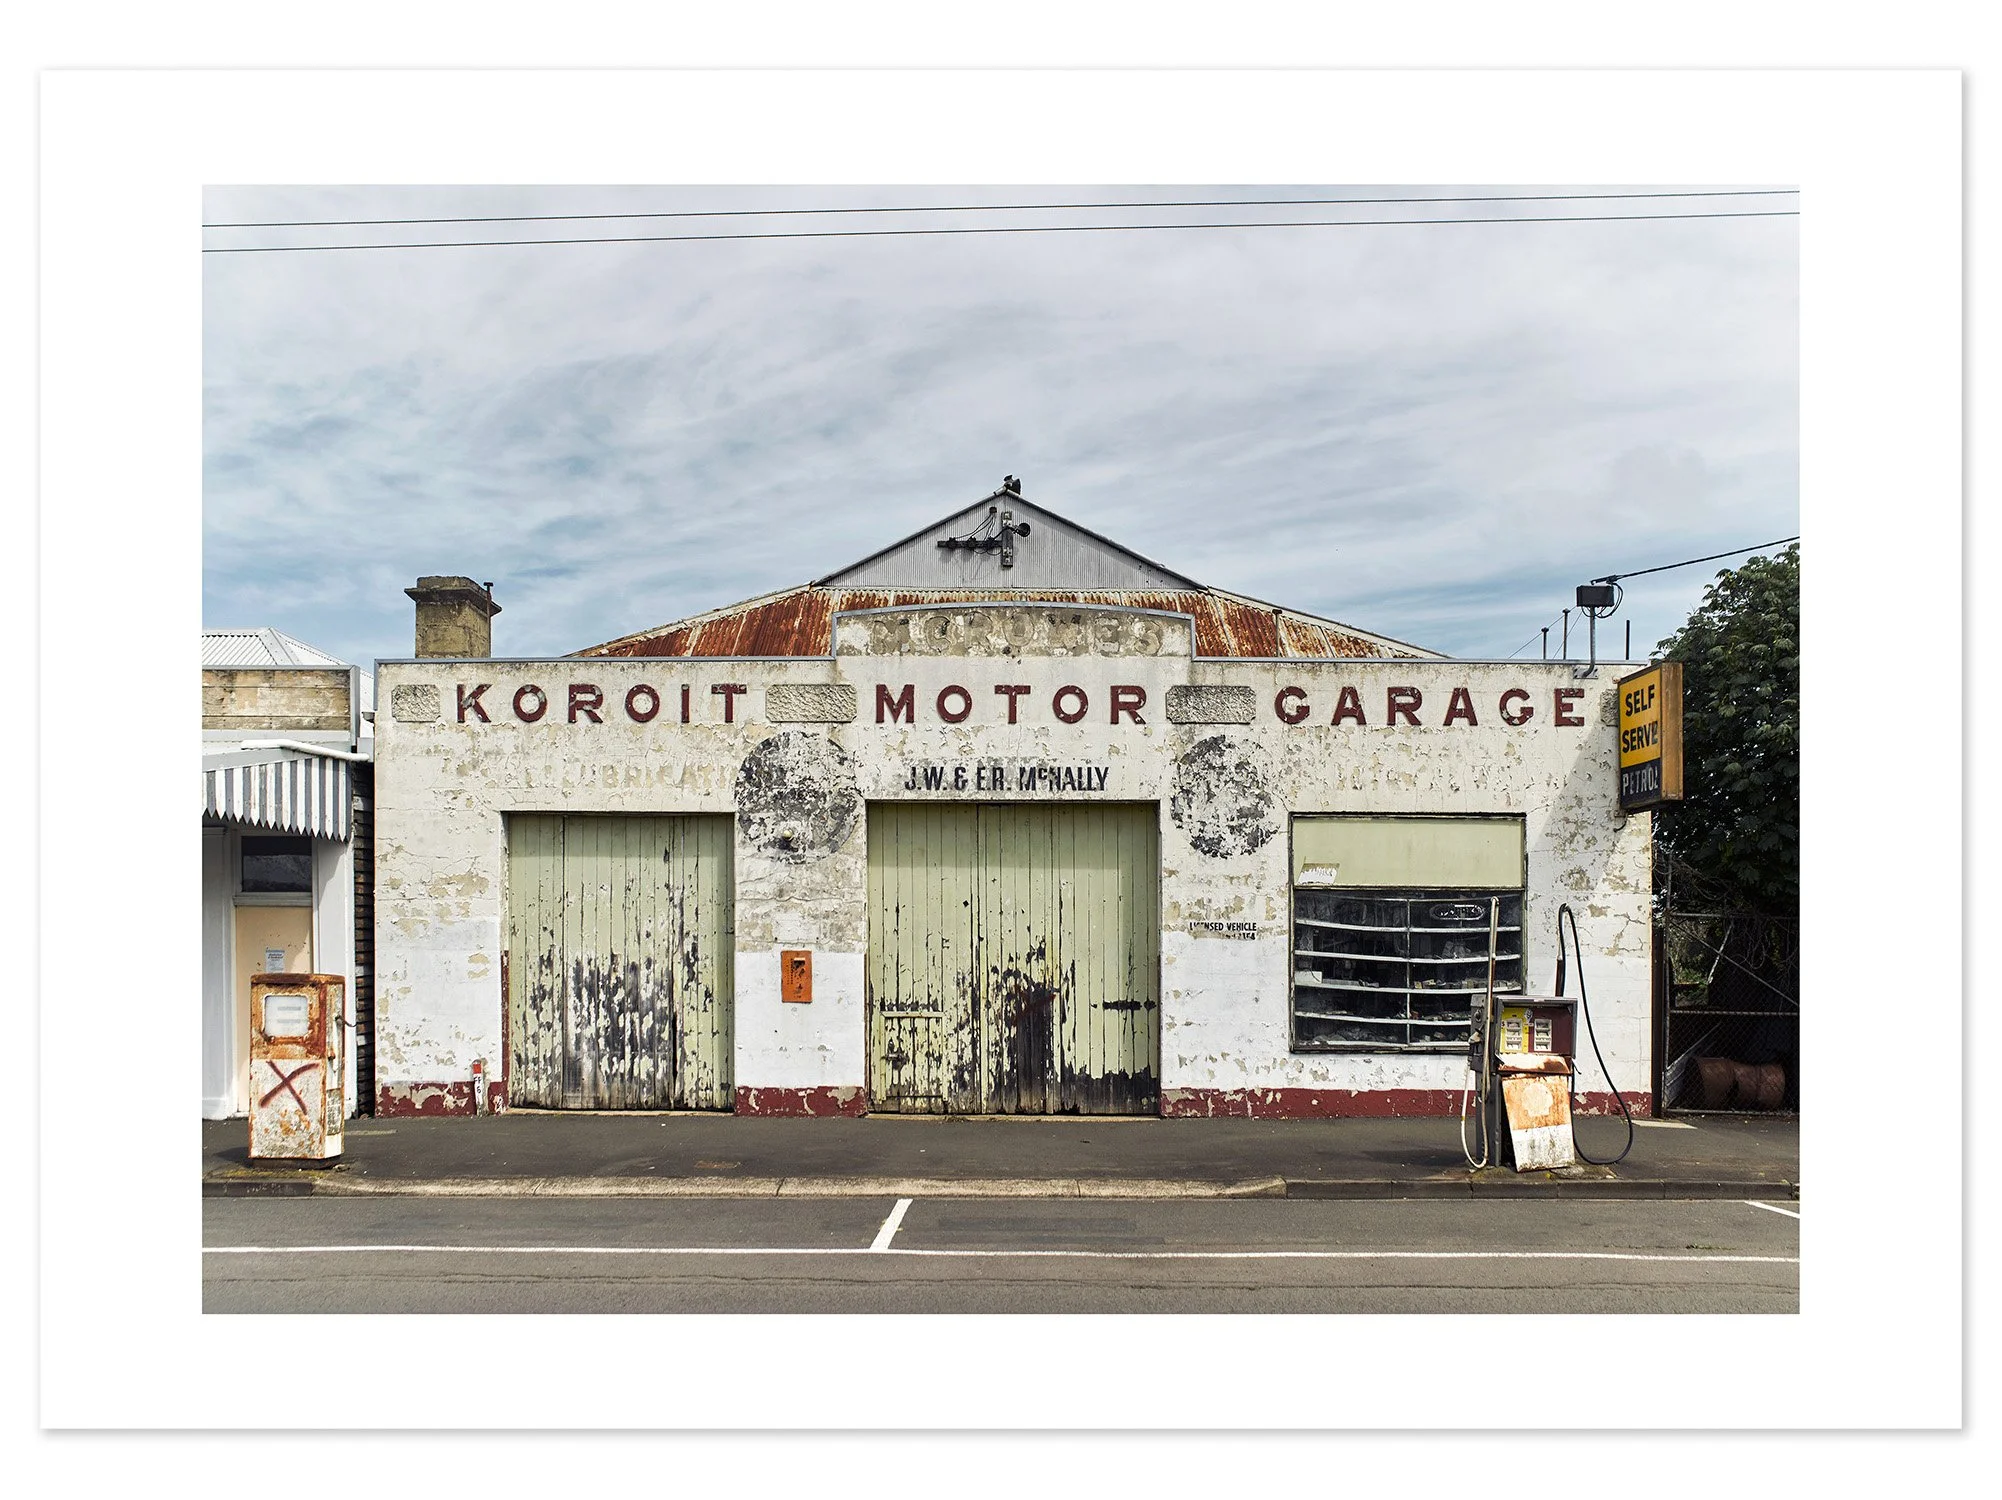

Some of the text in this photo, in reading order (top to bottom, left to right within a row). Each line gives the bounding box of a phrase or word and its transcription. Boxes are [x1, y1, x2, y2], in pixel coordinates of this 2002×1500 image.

[457, 684, 1585, 727] KOROIT MOTOR GARAGE
[1625, 684, 1655, 717] SELF
[1622, 720, 1659, 754] SERVE
[904, 766, 1110, 791] J.W. & E.R. McNALLY
[1622, 765, 1659, 796] PETROL
[1189, 922, 1257, 931] LNSED VEHICLE
